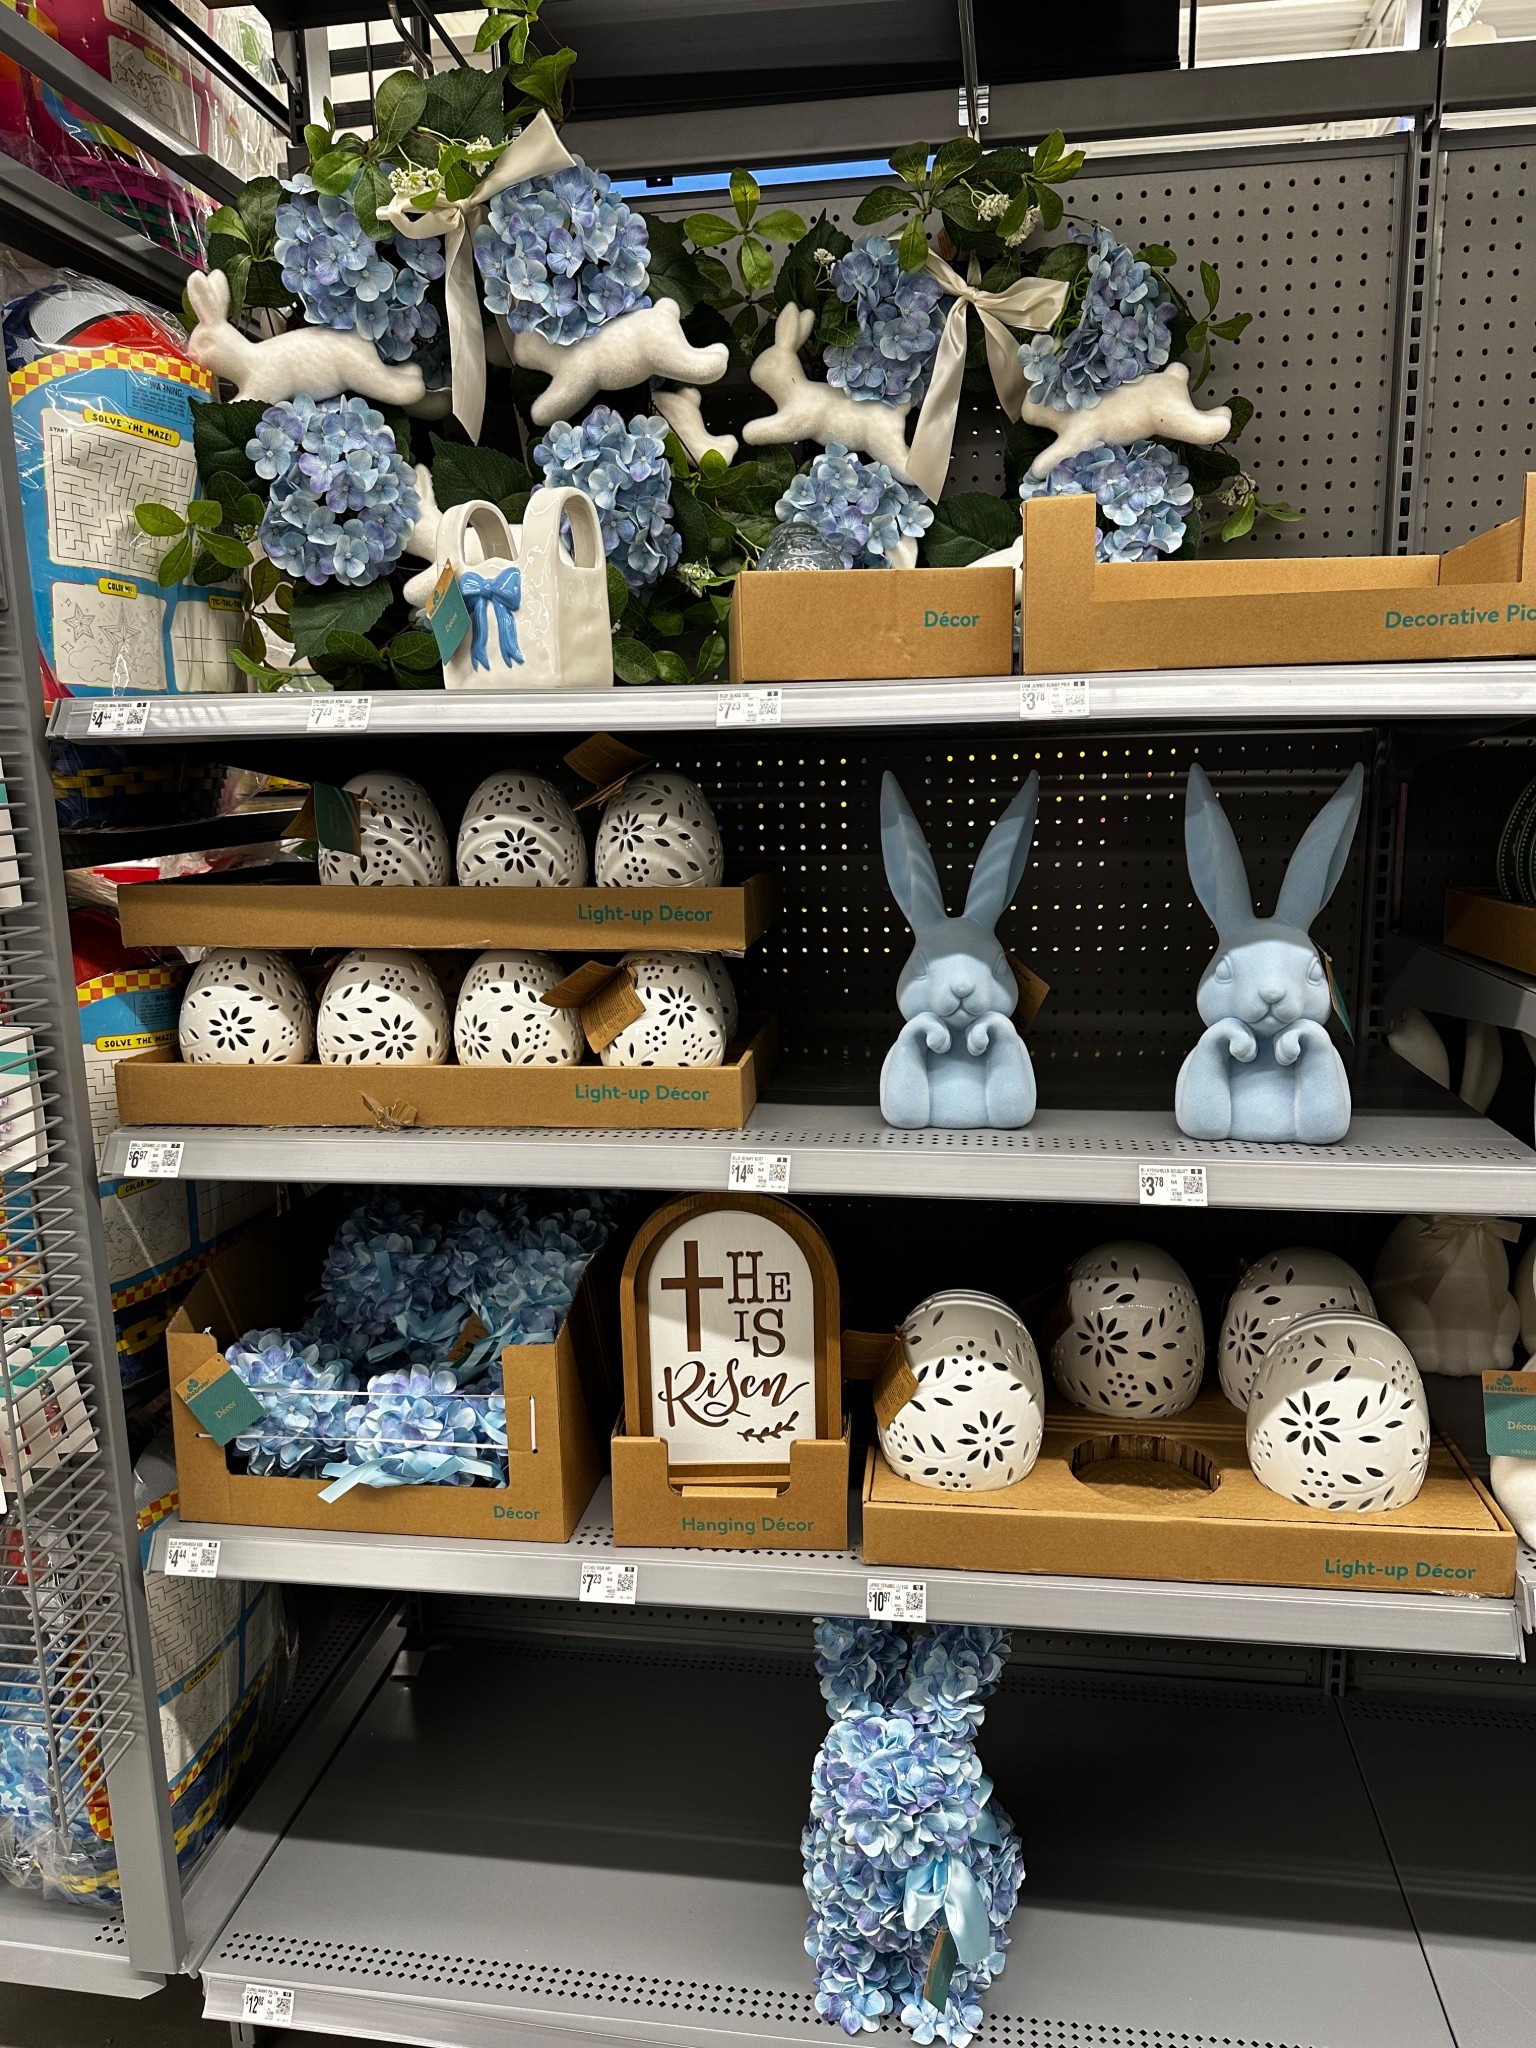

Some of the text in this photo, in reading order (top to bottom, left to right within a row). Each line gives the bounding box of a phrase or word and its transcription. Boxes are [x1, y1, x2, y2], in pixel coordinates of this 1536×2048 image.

[149, 380, 185, 398] WARNING:
[49, 426, 69, 434] START
[92, 413, 172, 442] SOLVE THE MAZE!
[924, 610, 980, 628] Décor
[1385, 606, 1500, 629] Decorative
[577, 903, 714, 926] Light-up Décor
[104, 1032, 175, 1048] SOLVE THE MAZE!
[575, 1083, 710, 1105] Light-up Décor
[125, 1180, 145, 1193] COLOR
[726, 1251, 791, 1305] HE
[734, 1308, 786, 1358] IS
[657, 1357, 810, 1428] Risen
[1485, 1383, 1527, 1393] Celebrate!
[215, 1401, 237, 1419] Décor
[493, 1505, 540, 1520] Décor
[682, 1516, 815, 1535] Hanging Décor
[1325, 1558, 1477, 1581] Light-up Décor
